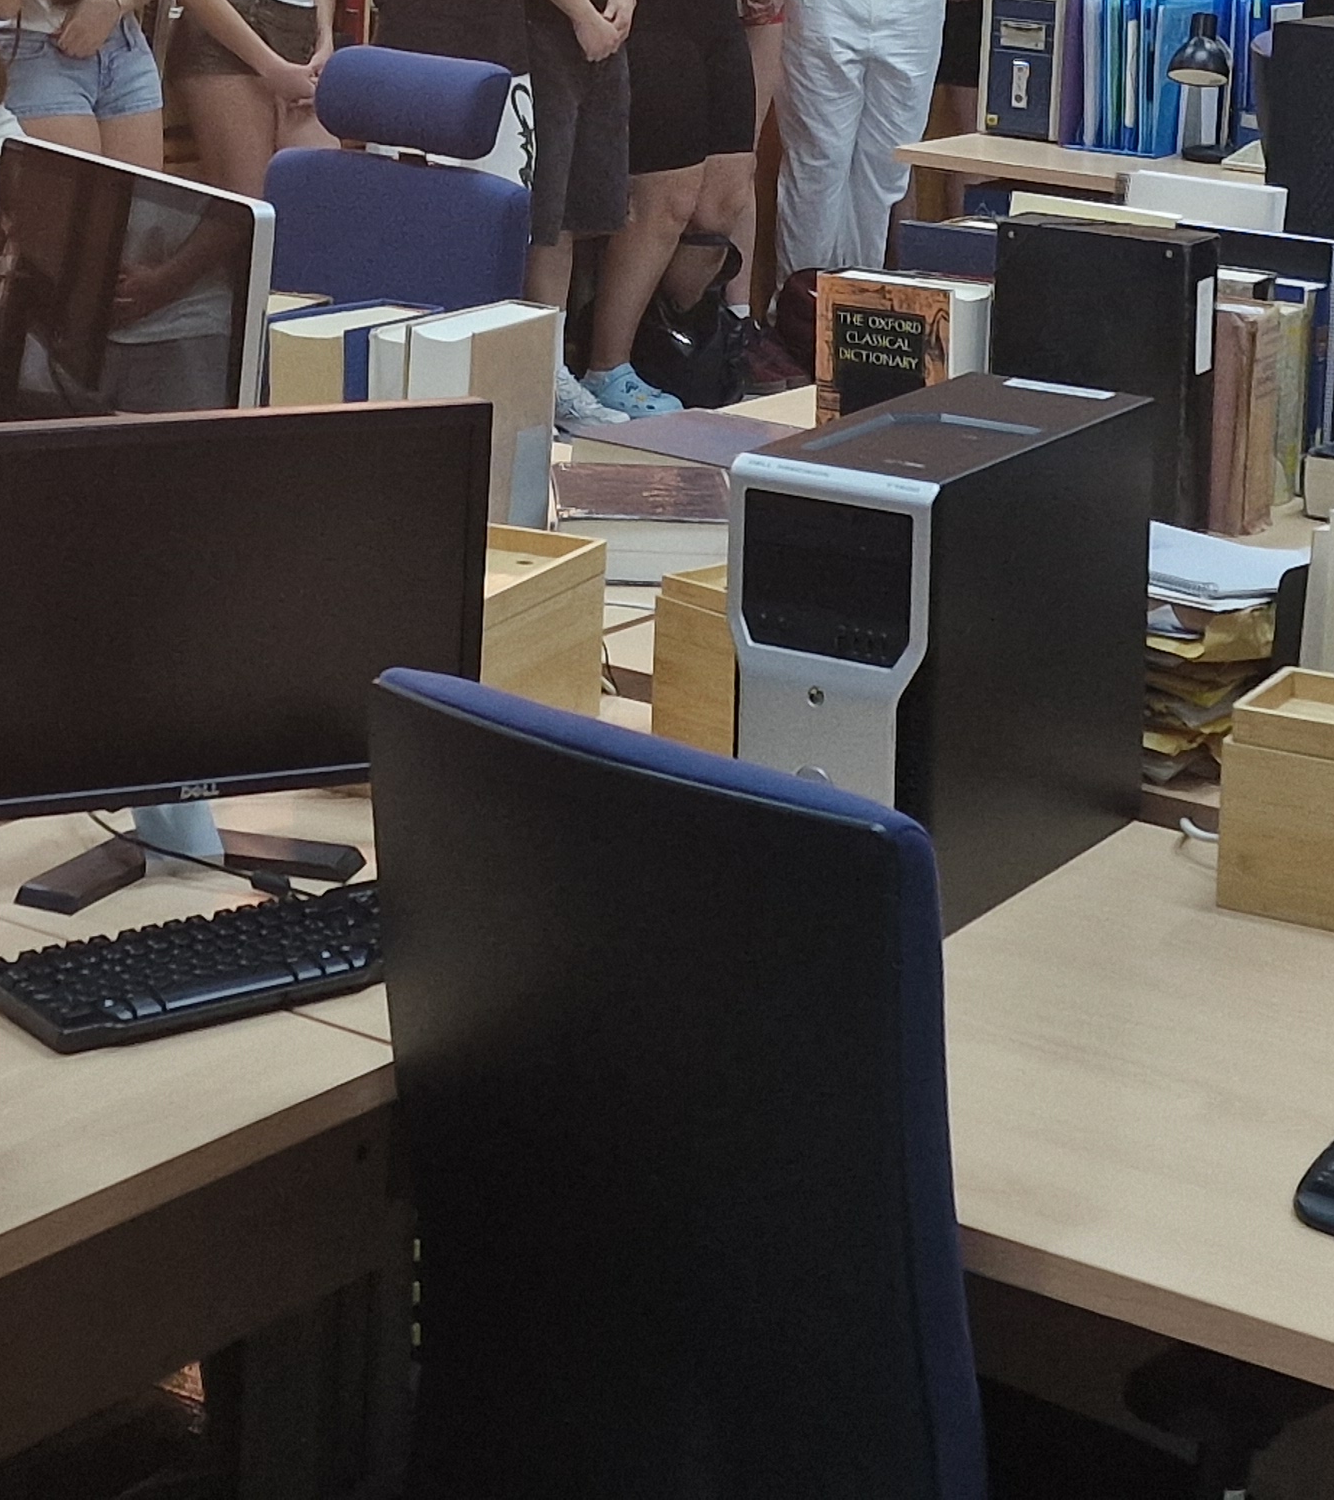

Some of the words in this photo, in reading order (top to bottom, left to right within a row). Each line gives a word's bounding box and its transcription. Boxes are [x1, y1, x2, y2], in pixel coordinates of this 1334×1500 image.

[837, 311, 863, 326] THE
[868, 315, 922, 334] OXFORD
[846, 330, 912, 352] CLASSICAL
[839, 347, 918, 369] DICTIONARY
[180, 782, 220, 799] DELL
